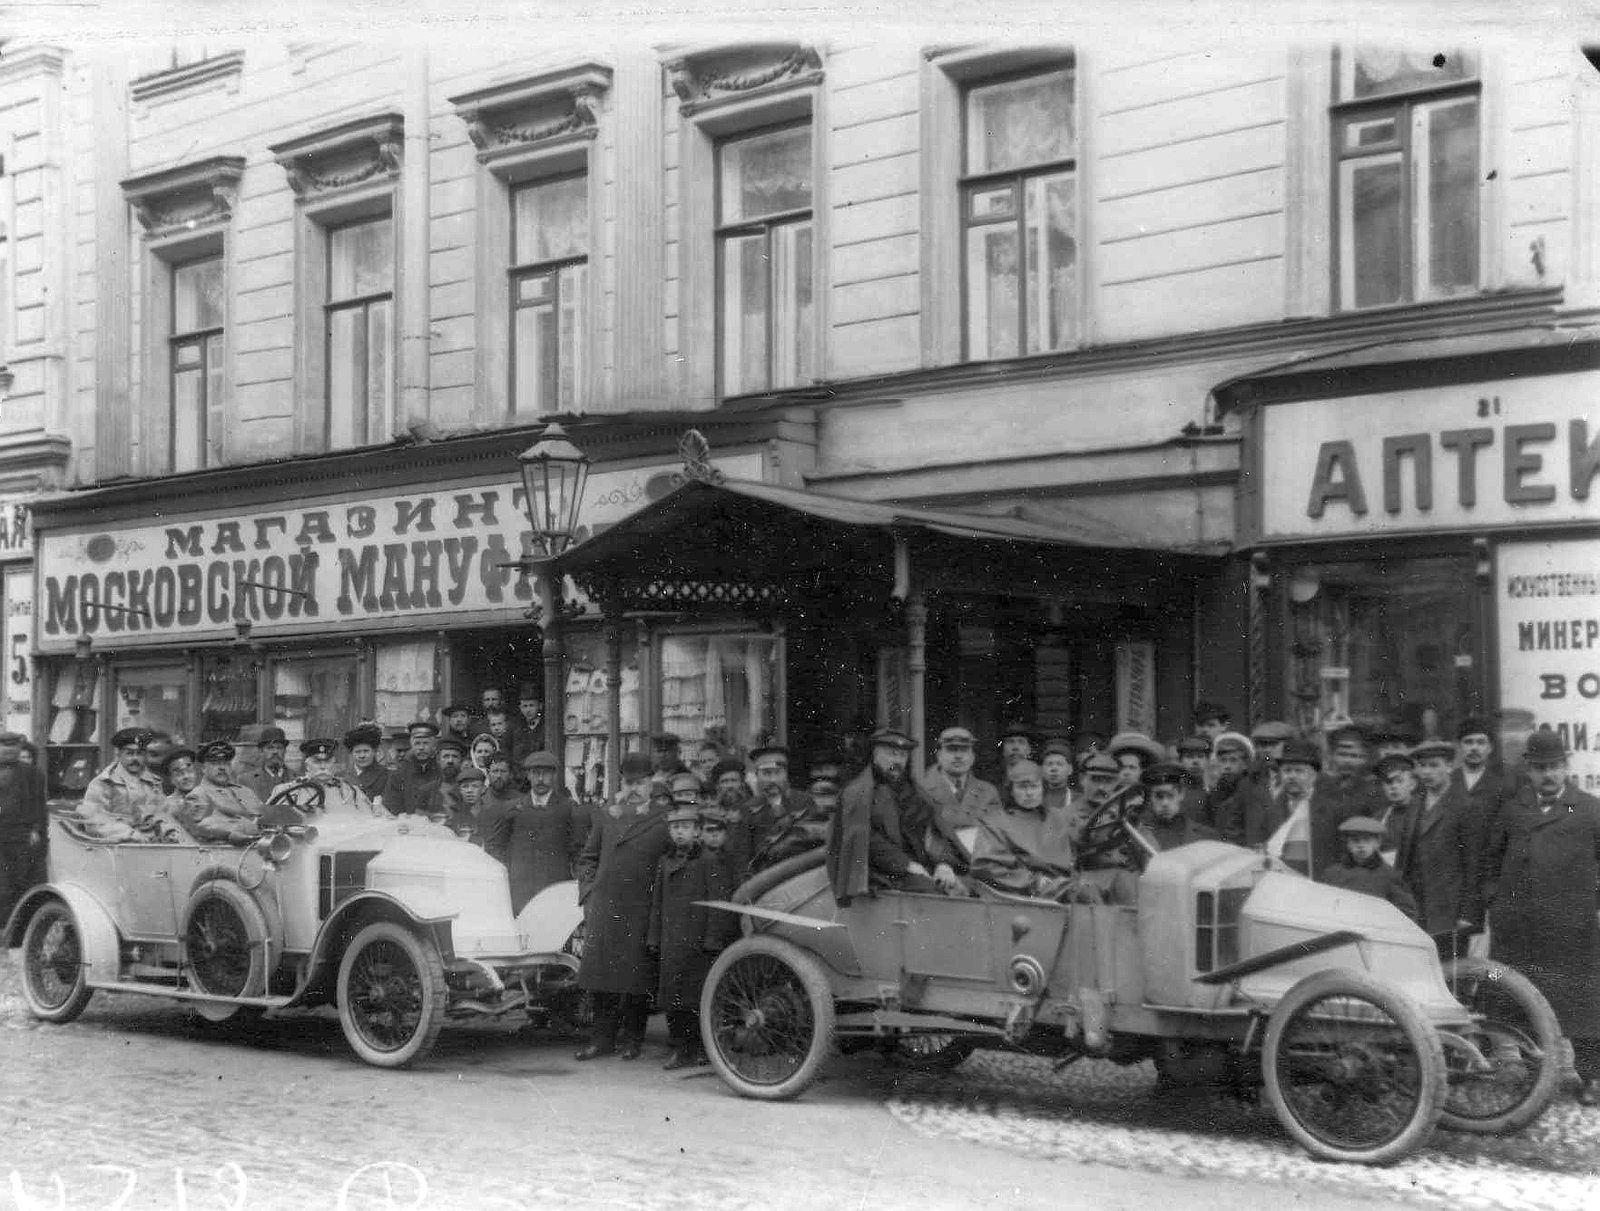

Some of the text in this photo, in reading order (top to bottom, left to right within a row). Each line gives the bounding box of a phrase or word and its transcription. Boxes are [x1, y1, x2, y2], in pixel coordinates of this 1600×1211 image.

[45, 550, 320, 635] МОСКОВСКОЙ
[1518, 619, 1599, 651] МИНЕР
[1539, 672, 1600, 699] ВО
